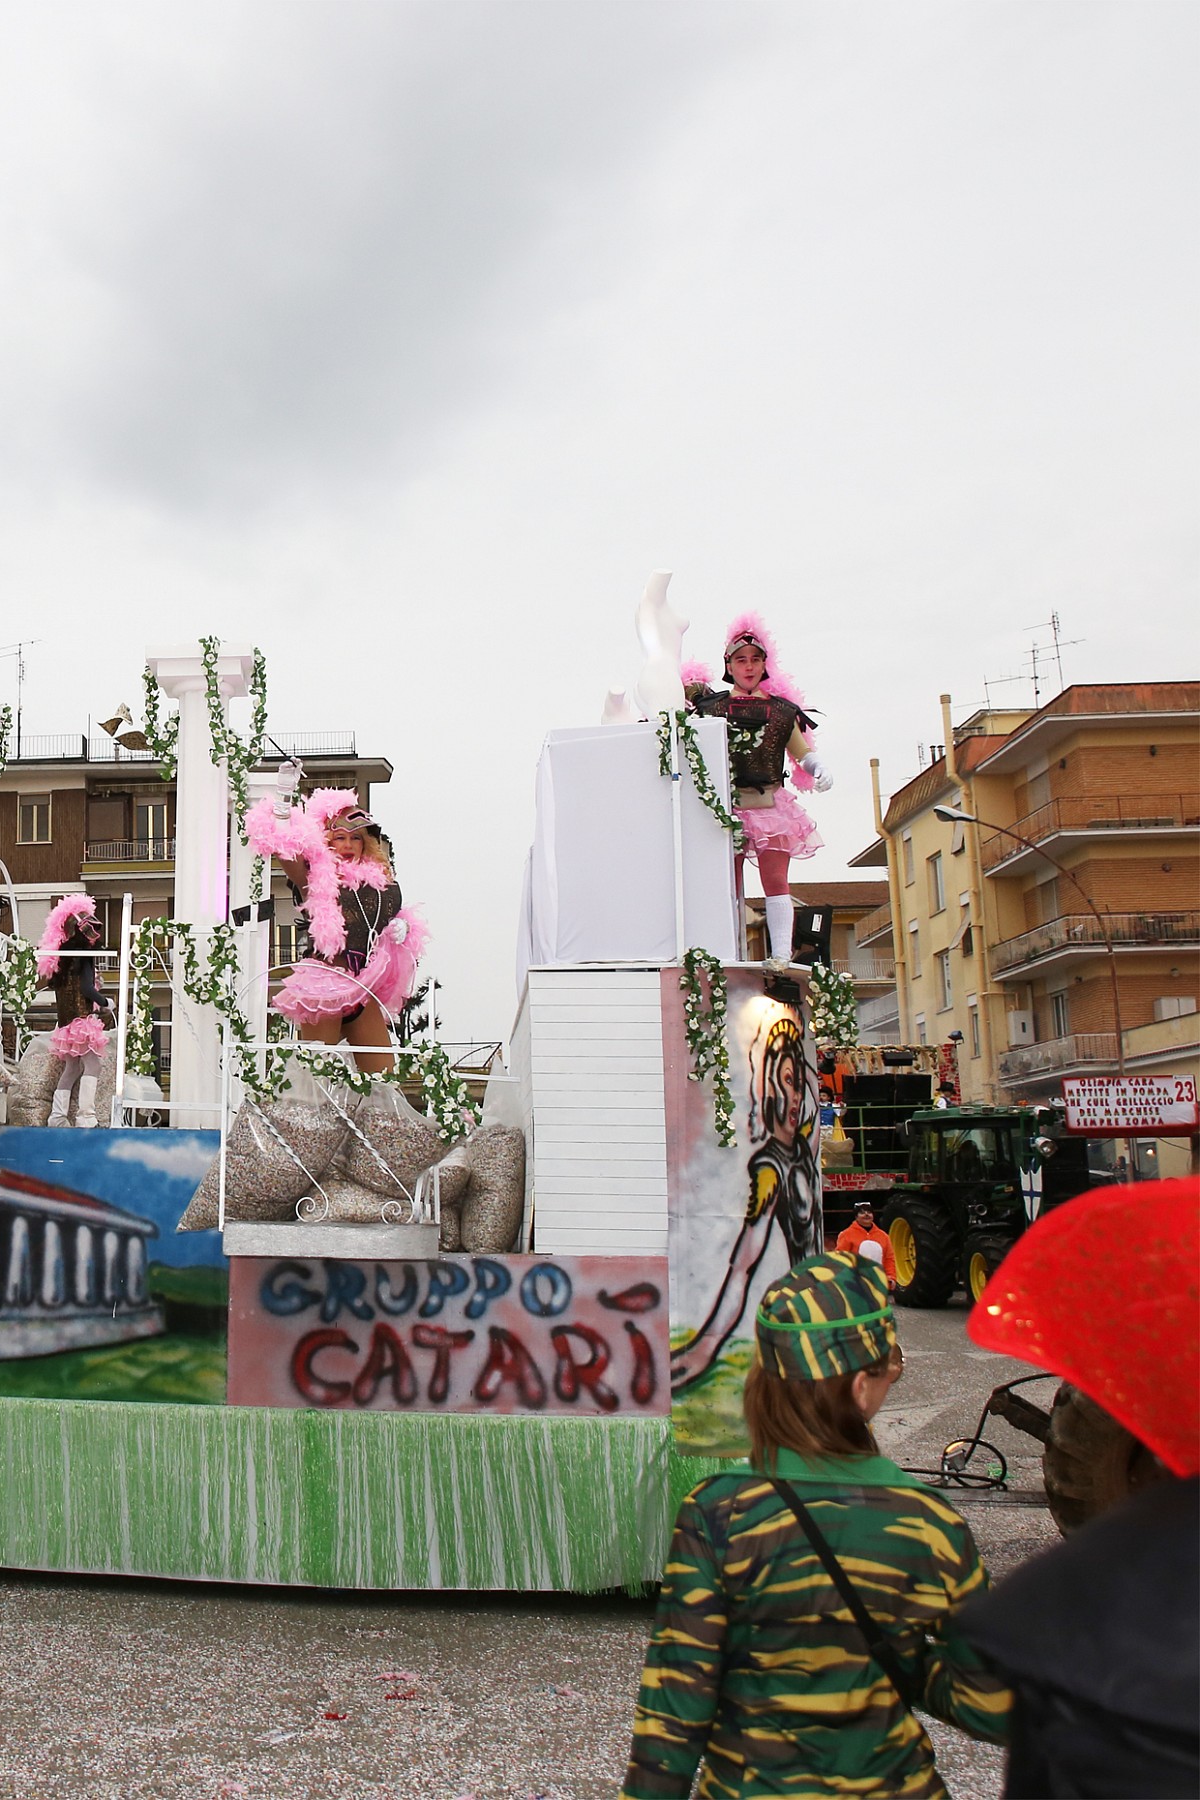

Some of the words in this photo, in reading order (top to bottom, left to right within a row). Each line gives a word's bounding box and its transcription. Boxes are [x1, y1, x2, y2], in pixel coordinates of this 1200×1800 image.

[1080, 1078, 1122, 1087] OLIMPIA
[1128, 1077, 1154, 1086] CARA
[1067, 1088, 1110, 1097] METTITE
[1116, 1087, 1127, 1096] IN
[1133, 1087, 1169, 1096] POMPA
[1174, 1080, 1194, 1102] 23
[1116, 1097, 1174, 1106] GRILLACCIO
[1079, 1108, 1097, 1117] DEL
[1104, 1106, 1160, 1116] MARCHESE
[1076, 1117, 1120, 1127] SEMPRE
[1125, 1116, 1164, 1126] ZOMPA
[260, 1257, 573, 1323] GRUPPO
